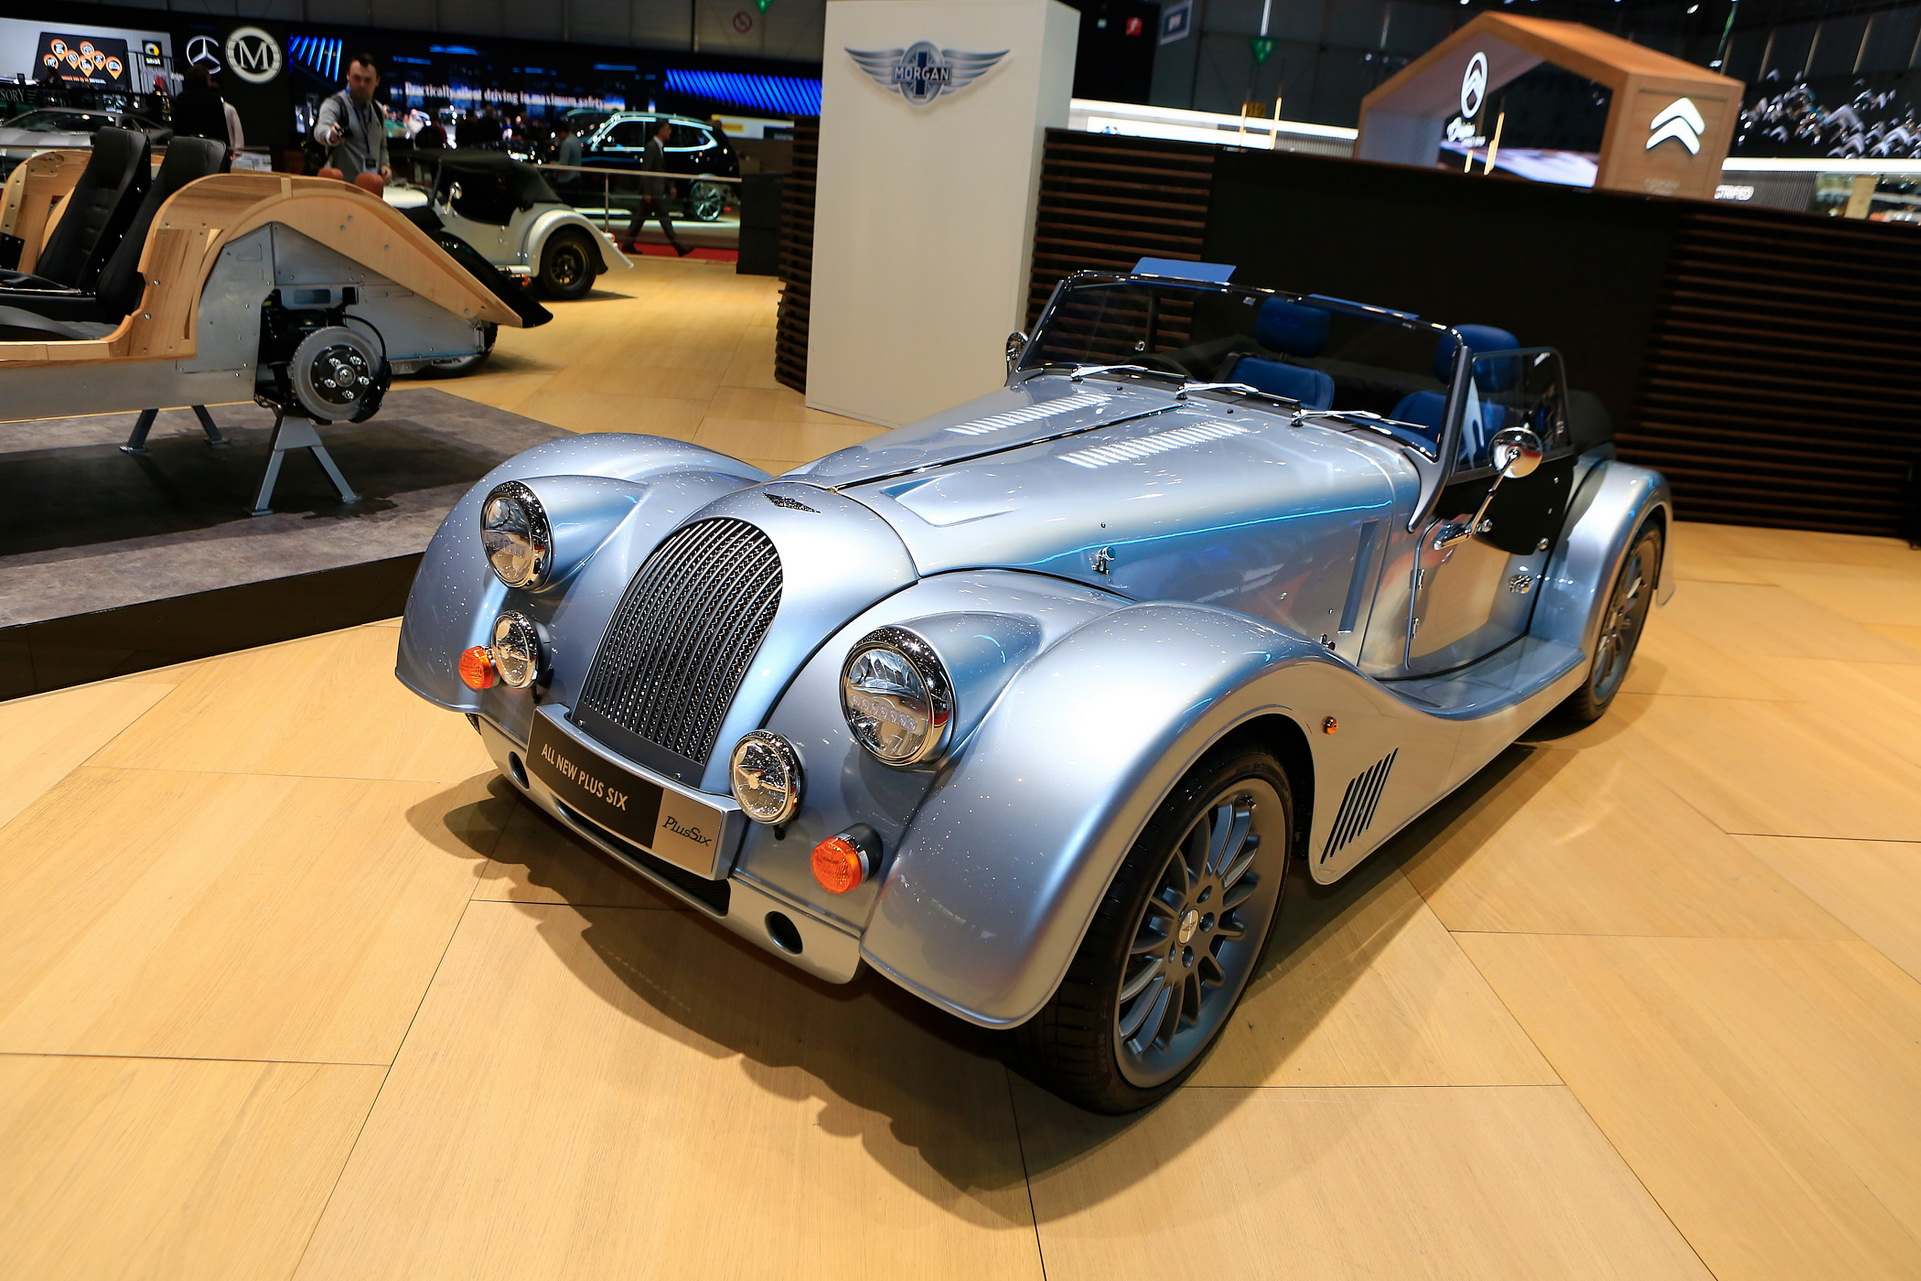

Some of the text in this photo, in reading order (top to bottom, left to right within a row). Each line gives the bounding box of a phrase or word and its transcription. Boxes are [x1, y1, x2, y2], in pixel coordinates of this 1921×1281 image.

[895, 65, 950, 81] MORGAN
[404, 81, 453, 99] Practically
[484, 88, 518, 106] driving
[520, 91, 528, 104] in
[531, 93, 577, 107] maximum
[579, 95, 605, 111] safety
[541, 743, 629, 811] ALL NEW PLUS SIX
